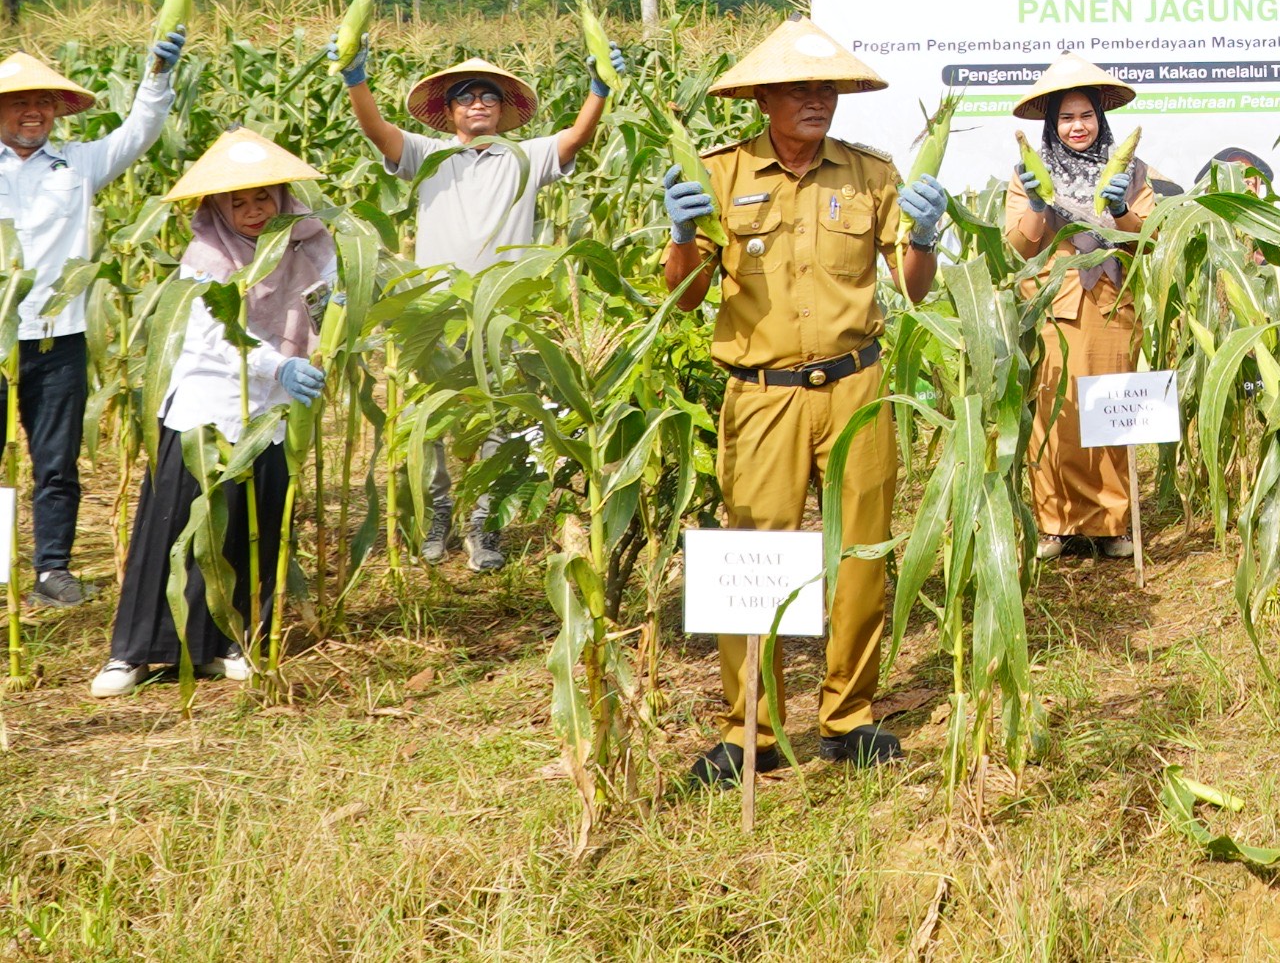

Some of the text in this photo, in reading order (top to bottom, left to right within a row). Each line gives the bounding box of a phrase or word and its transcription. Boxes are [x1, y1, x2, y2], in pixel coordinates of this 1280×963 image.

[853, 40, 921, 55] Program
[927, 39, 1051, 54] Pengembangan
[1057, 38, 1085, 50] dan
[1091, 36, 1206, 52] Pemberdayaan
[958, 68, 1046, 84] Pengemba
[1105, 66, 1155, 82] didaya
[1159, 66, 1208, 79] Kakao
[1212, 64, 1267, 78] melalui
[1126, 96, 1236, 113] Kesejahteraan
[1103, 403, 1154, 415] GUNUNG
[1109, 418, 1149, 428] TABUR
[724, 552, 784, 566] CAMAT
[718, 574, 790, 588] GUNUNG
[727, 595, 785, 609] TABUR
